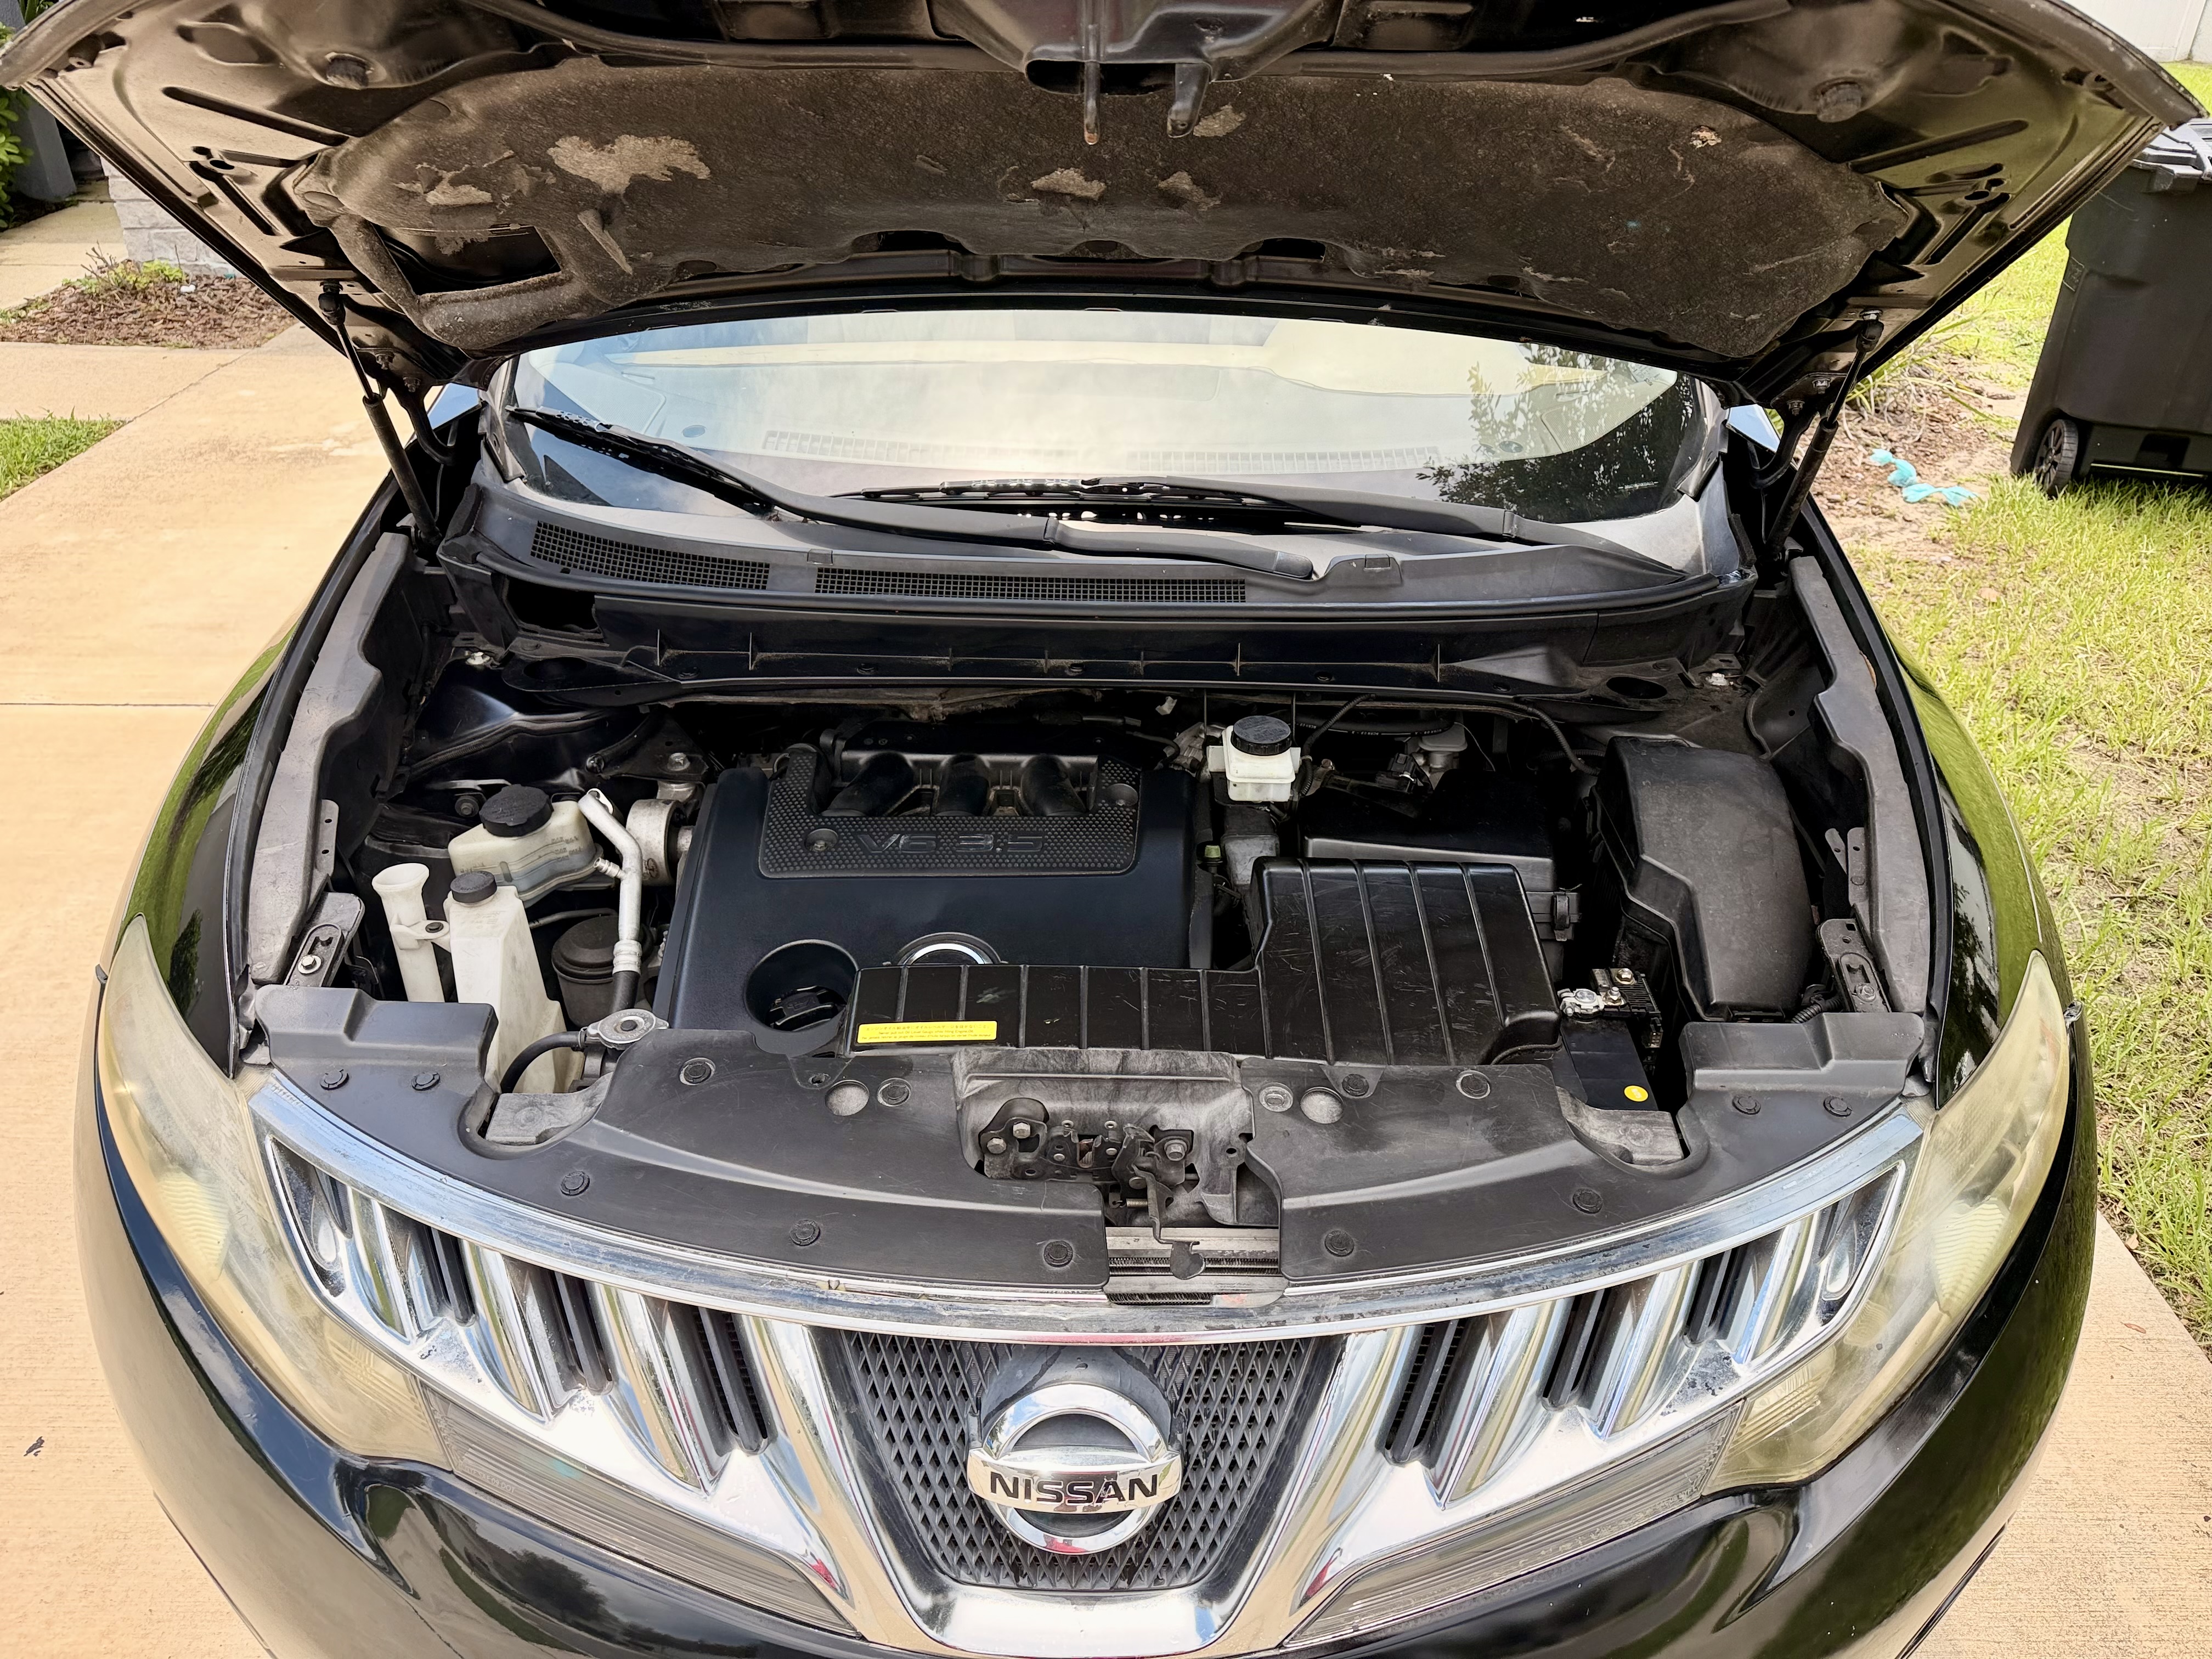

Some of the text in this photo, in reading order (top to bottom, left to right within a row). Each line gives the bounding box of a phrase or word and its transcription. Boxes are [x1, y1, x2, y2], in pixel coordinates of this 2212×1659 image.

[857, 833, 1043, 854] V6 3.5
[500, 1482, 516, 1493] DOT
[990, 1471, 1158, 1505] NISSAN
